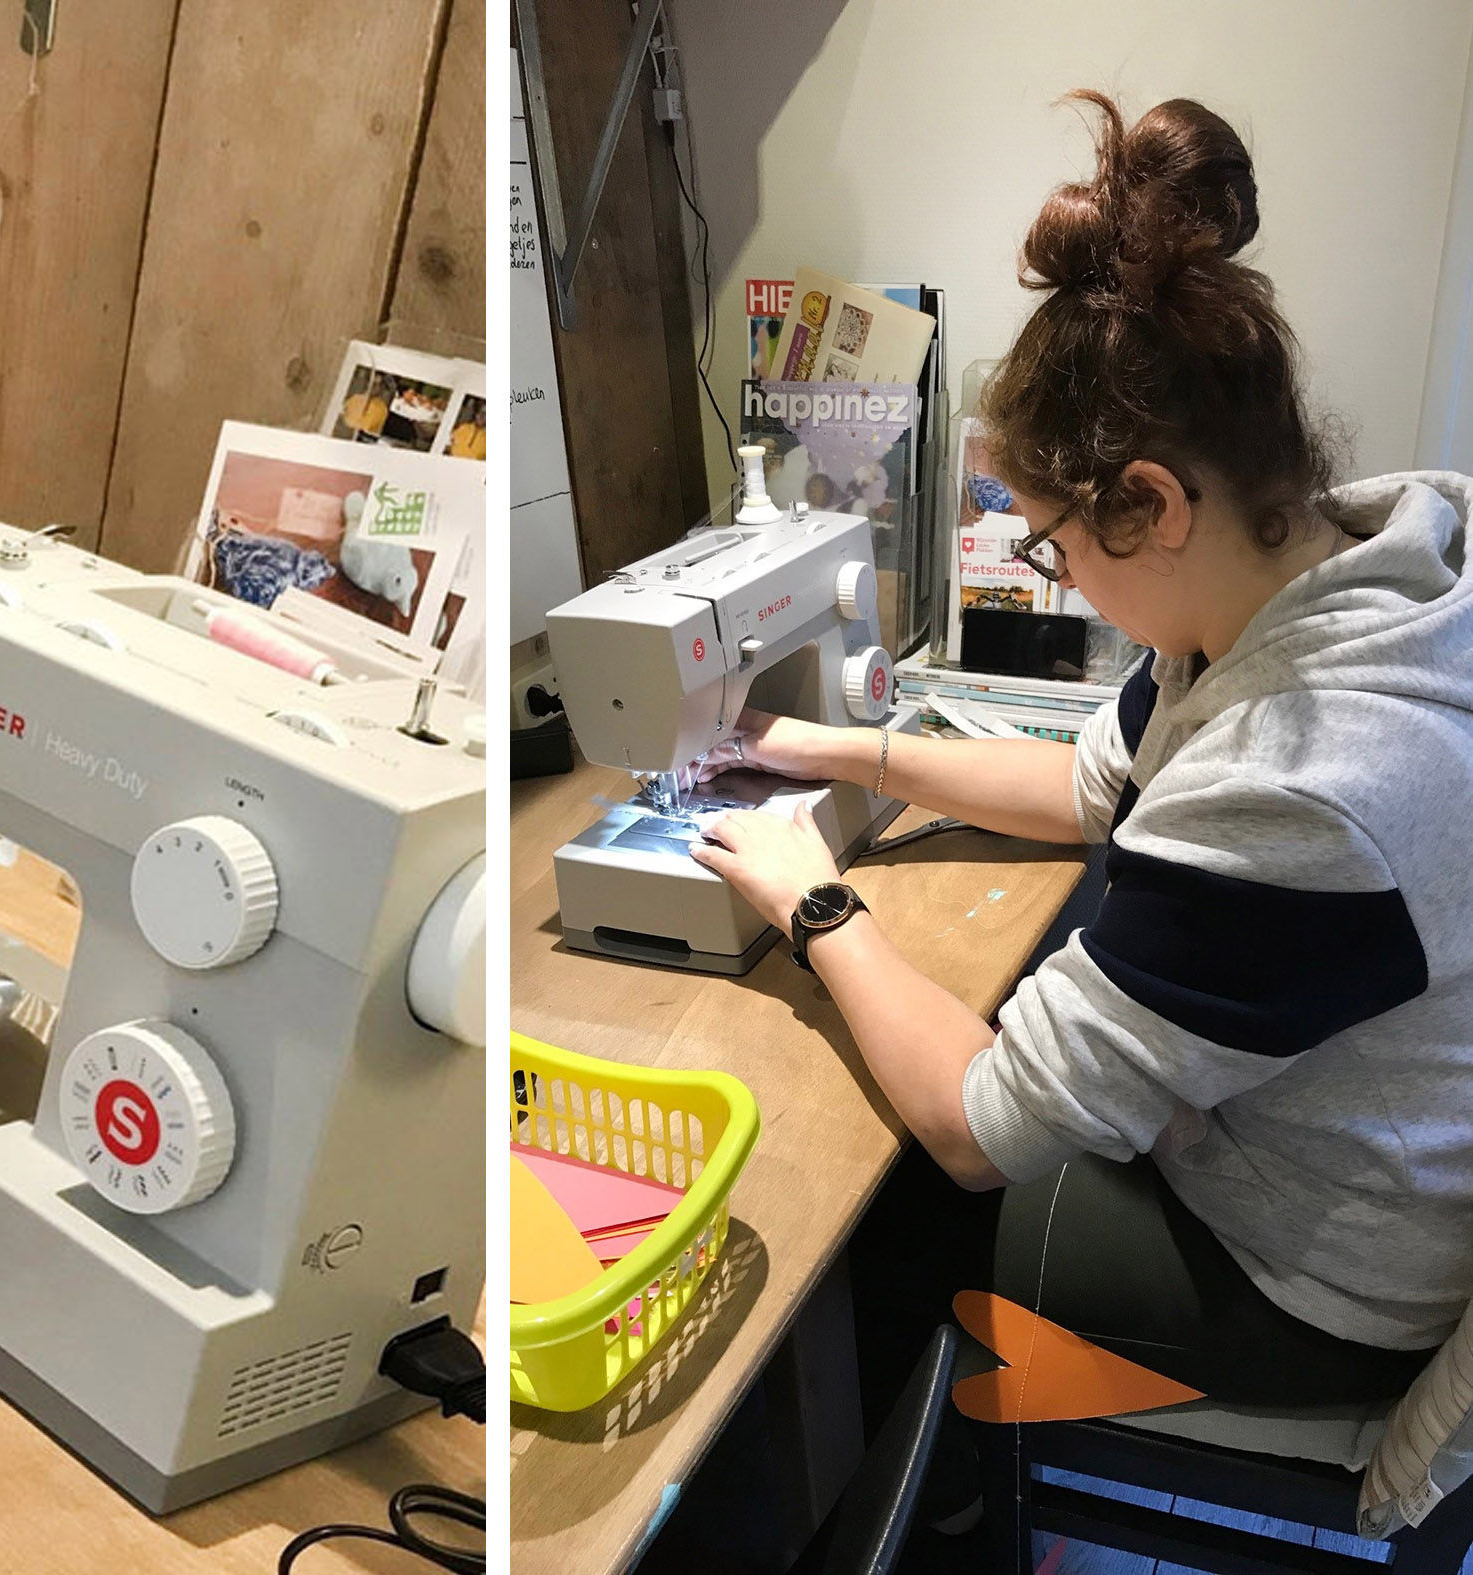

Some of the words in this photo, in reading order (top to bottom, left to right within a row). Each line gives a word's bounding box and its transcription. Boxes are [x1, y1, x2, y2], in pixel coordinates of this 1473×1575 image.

[812, 295, 823, 304] 2
[744, 384, 909, 428] happinez
[959, 562, 1036, 577] Fietsroutes
[758, 595, 792, 622] SINGER
[44, 731, 101, 778] Heavy
[102, 757, 149, 800] Duty
[225, 777, 265, 801] LENGTH
[107, 1095, 147, 1150] S
